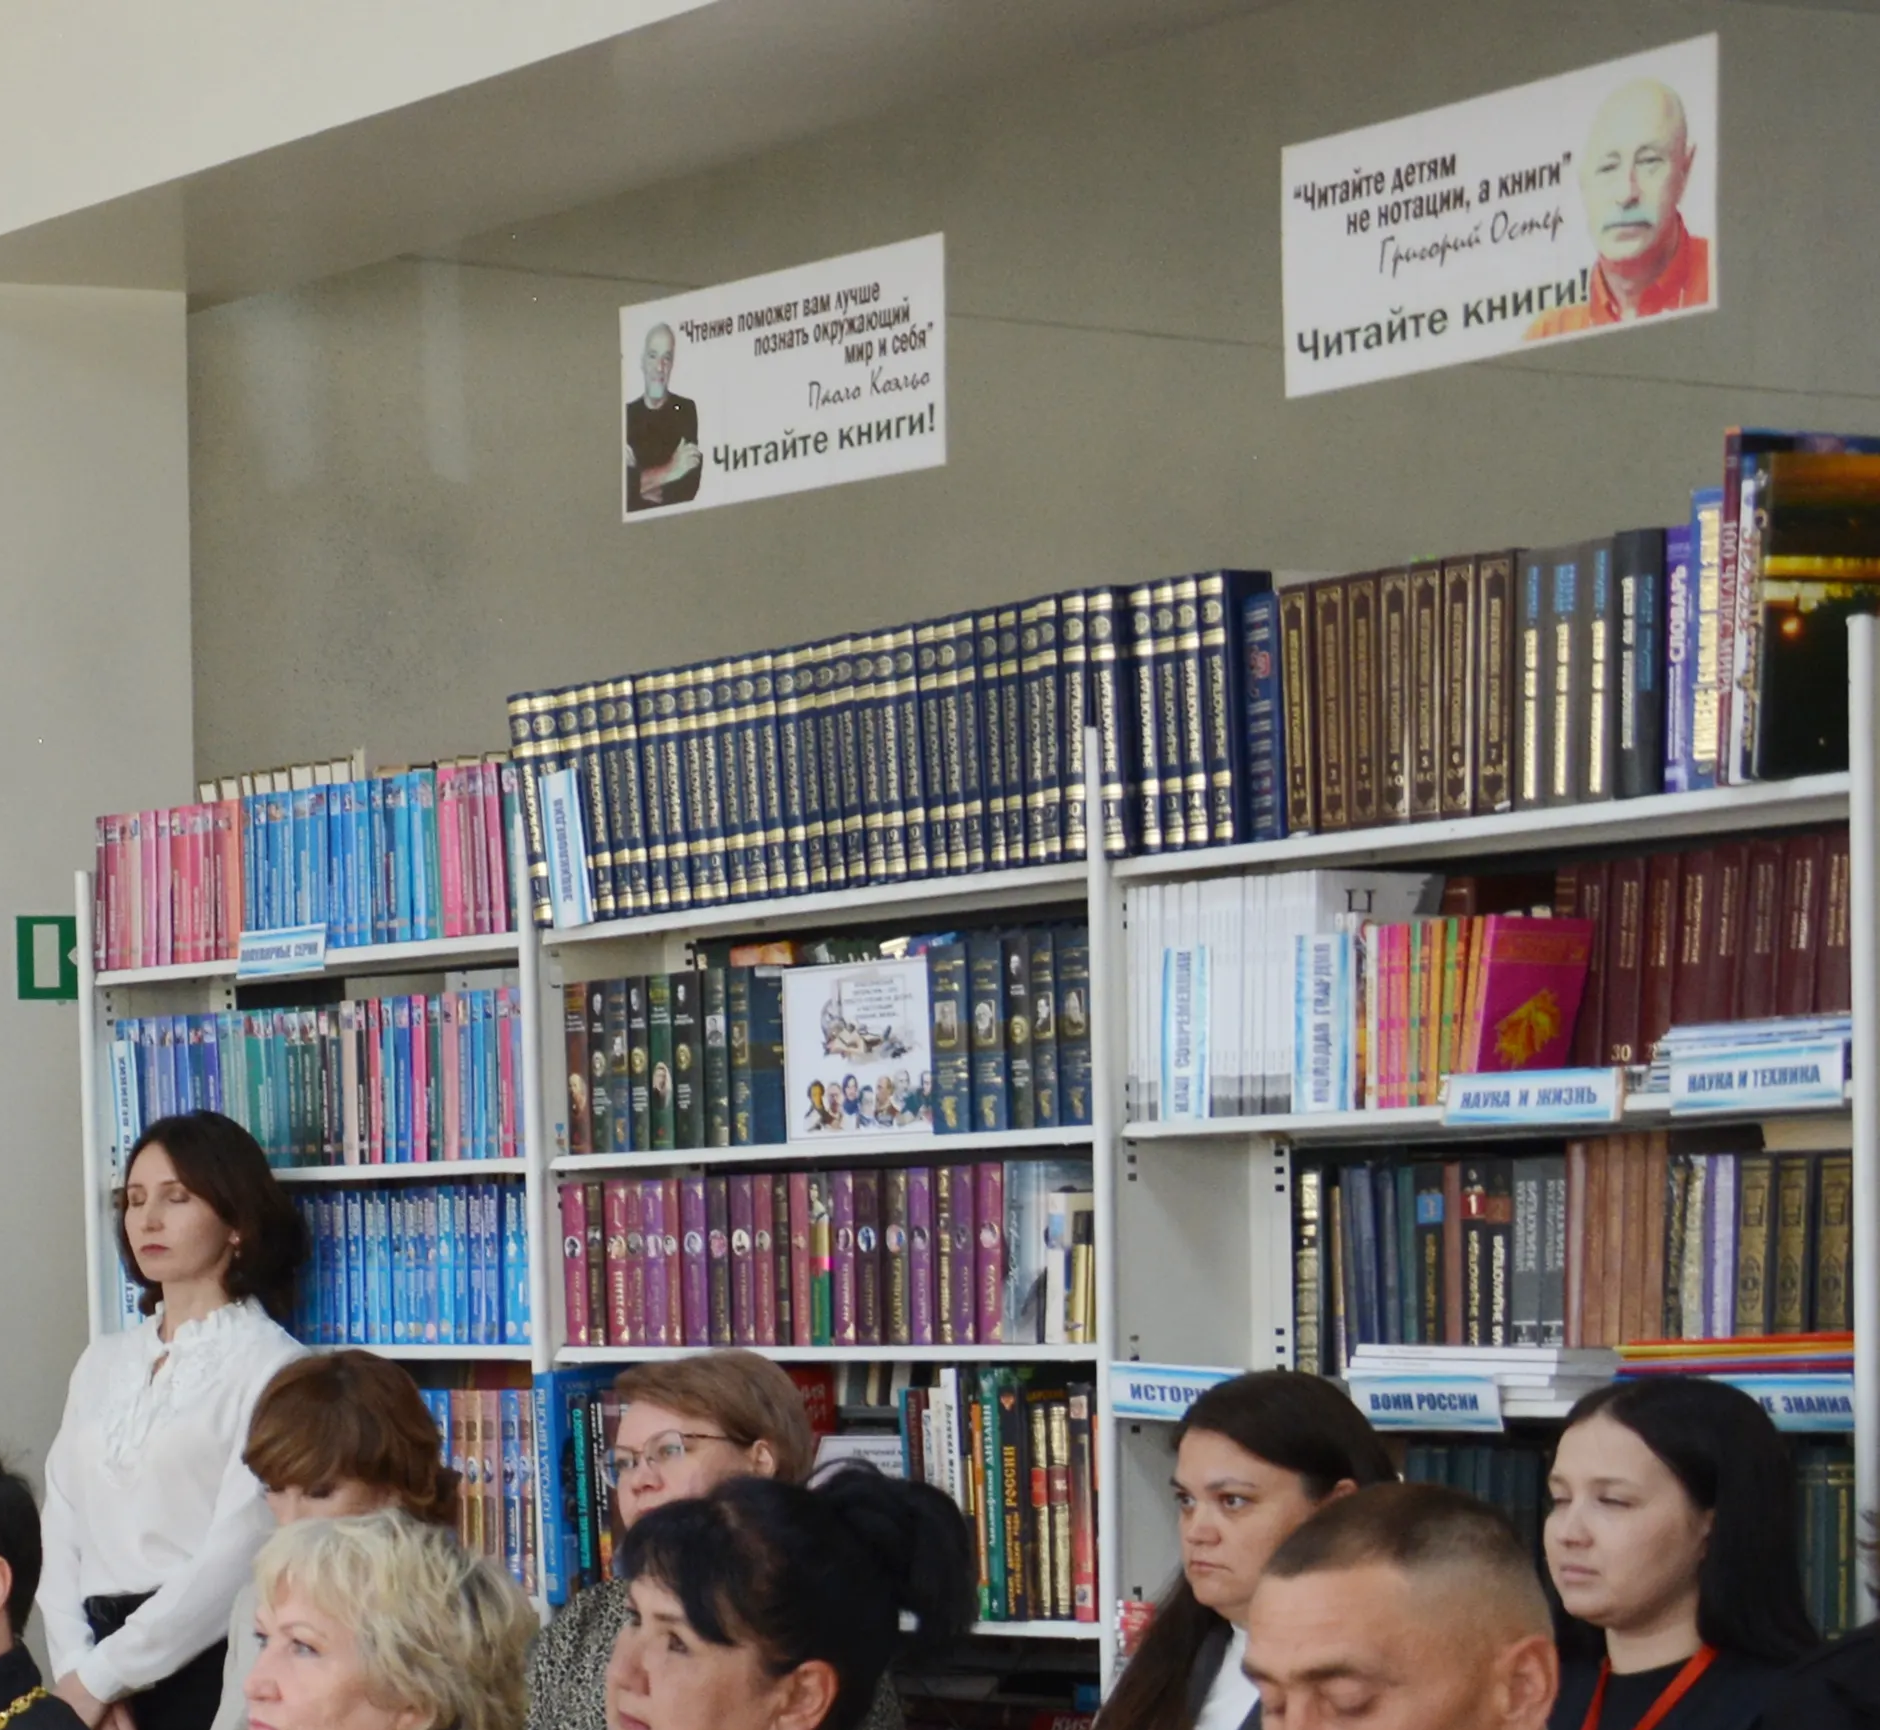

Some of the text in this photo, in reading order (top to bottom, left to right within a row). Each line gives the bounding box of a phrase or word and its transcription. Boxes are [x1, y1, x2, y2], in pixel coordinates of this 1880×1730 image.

[1391, 153, 1456, 194] детям
[1346, 205, 1370, 235] не
[1377, 187, 1471, 230] нотации,
[1478, 184, 1490, 204] а
[1490, 206, 1564, 242] Остер
[737, 301, 798, 334] поможет
[802, 293, 831, 316] вам
[834, 281, 881, 315] лучше
[754, 297, 910, 356] познать окружающий
[1297, 268, 1589, 363] Читайте книги!
[844, 339, 874, 366] мир
[878, 337, 887, 357] и
[712, 402, 936, 473] Читайте книги!
[1669, 564, 1688, 662] СЛОВАРЬ
[1460, 1085, 1597, 1109] НАУКА И ЖИЗНЬ
[1687, 1064, 1821, 1094] НАУКА И ТЕХНИКА
[1370, 1391, 1479, 1412] ВОИН РОССИИ
[1782, 1395, 1852, 1415] ЗНАНИЯ
[982, 1404, 994, 1466] ДИЗАЙН
[1002, 1445, 1017, 1507] РОССИИ
